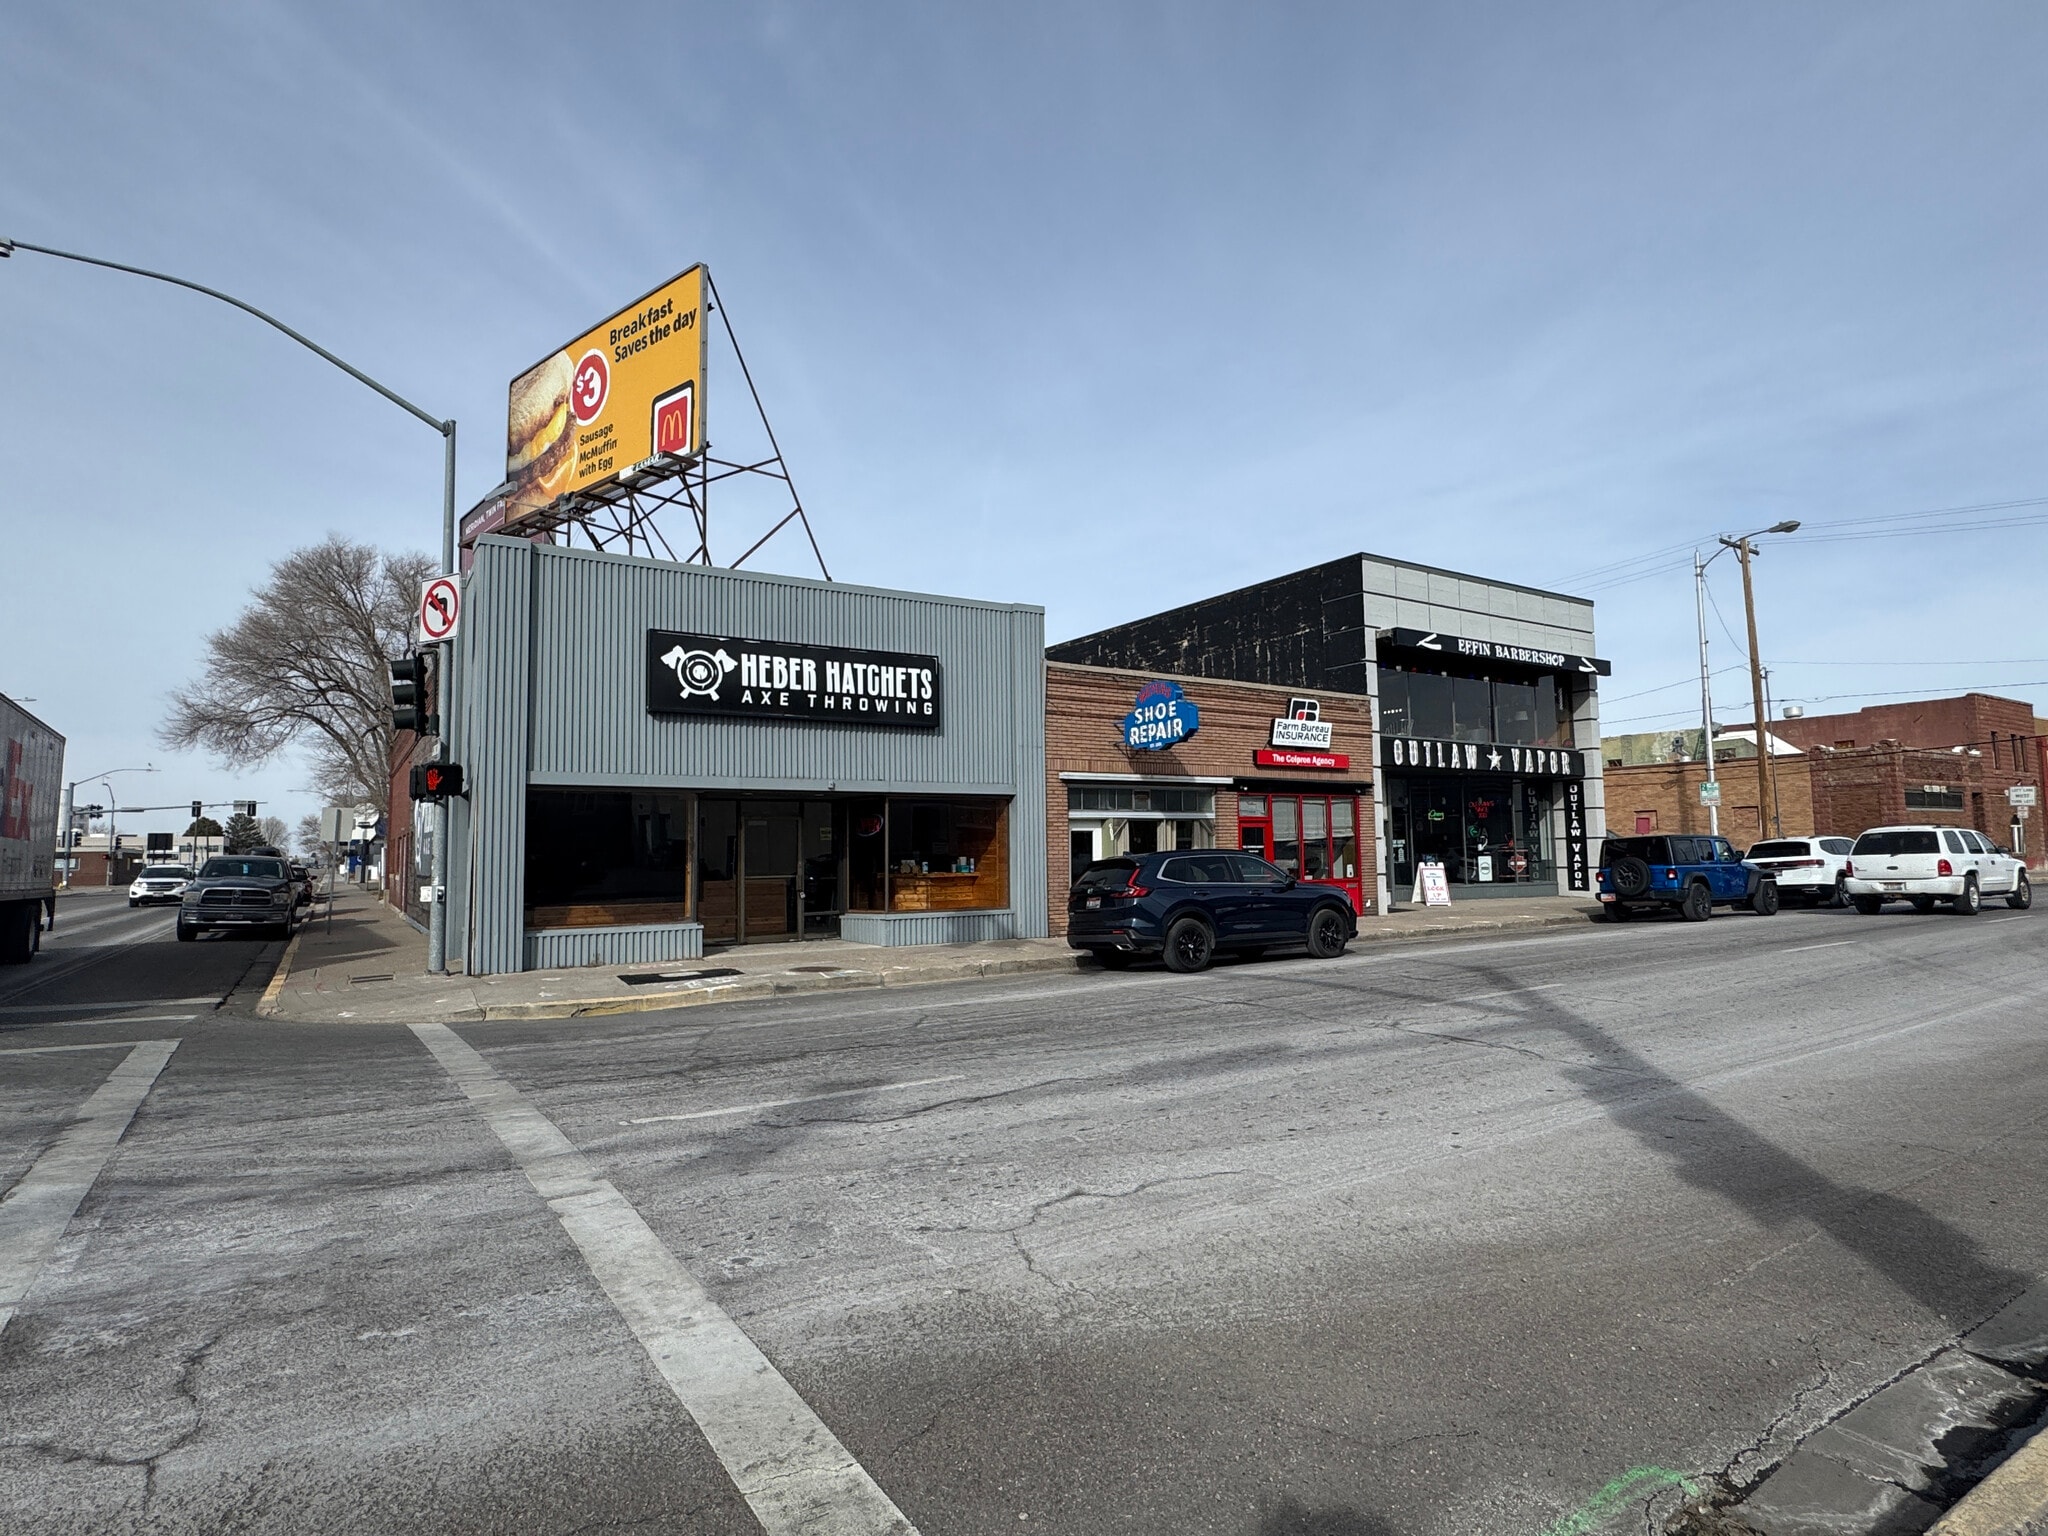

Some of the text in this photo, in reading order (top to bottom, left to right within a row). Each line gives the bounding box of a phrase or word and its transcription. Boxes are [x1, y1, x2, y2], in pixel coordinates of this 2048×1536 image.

[609, 297, 673, 346] Breakfast
[614, 307, 698, 363] Saves the day
[576, 366, 602, 408] $3
[579, 423, 614, 446] Sausage
[578, 439, 619, 464] McMuffin
[578, 455, 614, 479] with Egg
[1457, 638, 1566, 667] EFFIN BARBERSHOP
[740, 653, 933, 700] HEBER HATCHETS
[741, 690, 933, 716] AXE THROWING
[1134, 700, 1177, 725] SHOE
[1129, 718, 1184, 746] REPAIR
[1275, 730, 1329, 743] INSURANCE
[1276, 721, 1330, 734] Farm Bureau
[1272, 753, 1284, 763] The
[1312, 756, 1336, 767] Agency
[1393, 739, 1571, 775] OUTLAW VAPOR
[1569, 784, 1583, 888] OUTLAW VAPOR
